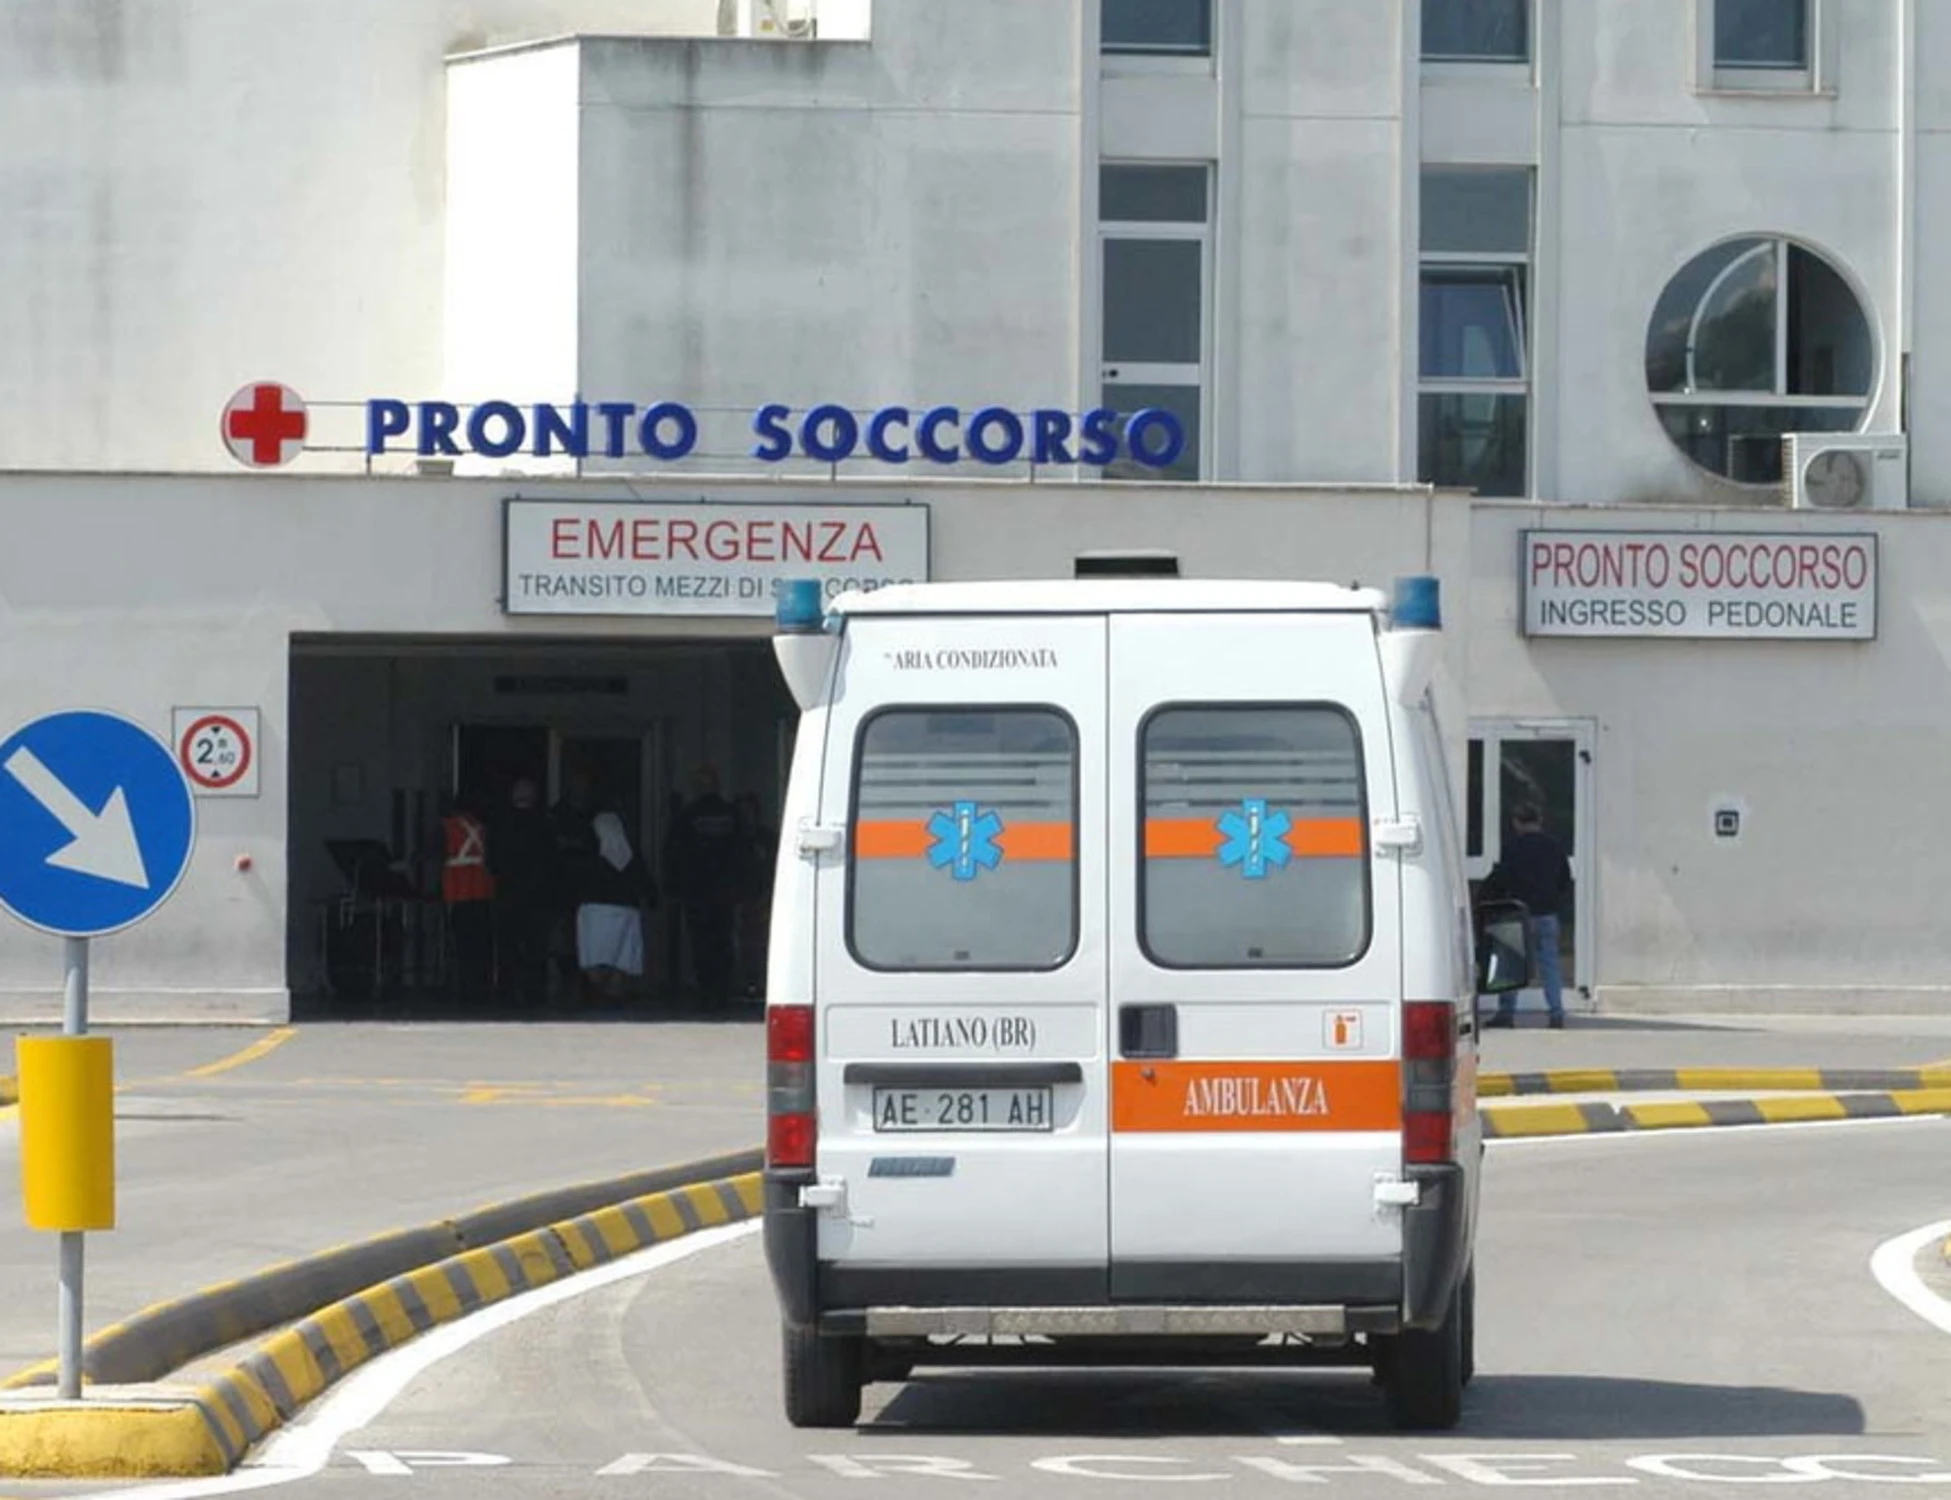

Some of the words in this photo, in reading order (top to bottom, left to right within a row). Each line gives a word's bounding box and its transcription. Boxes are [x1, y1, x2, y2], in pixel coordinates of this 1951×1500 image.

[367, 399, 698, 460] PRONTO
[752, 403, 1187, 468] SOCCORSO
[550, 518, 883, 563] EMERGENZA
[1532, 543, 1670, 588] PRONTO
[1679, 543, 1867, 590] SOCCORSO
[519, 574, 647, 598] TRANSITO
[655, 575, 729, 599] MEZZI
[739, 576, 763, 599] DI
[1540, 600, 1687, 627] INGRESSO
[1707, 601, 1857, 628] PEDONALE
[936, 649, 1058, 669] CONDIZIONATA
[892, 1018, 987, 1048] LATIANO
[992, 1017, 1037, 1052] (BR)
[1007, 1092, 1044, 1125] AH
[1183, 1076, 1330, 1116] AMBULANZA
